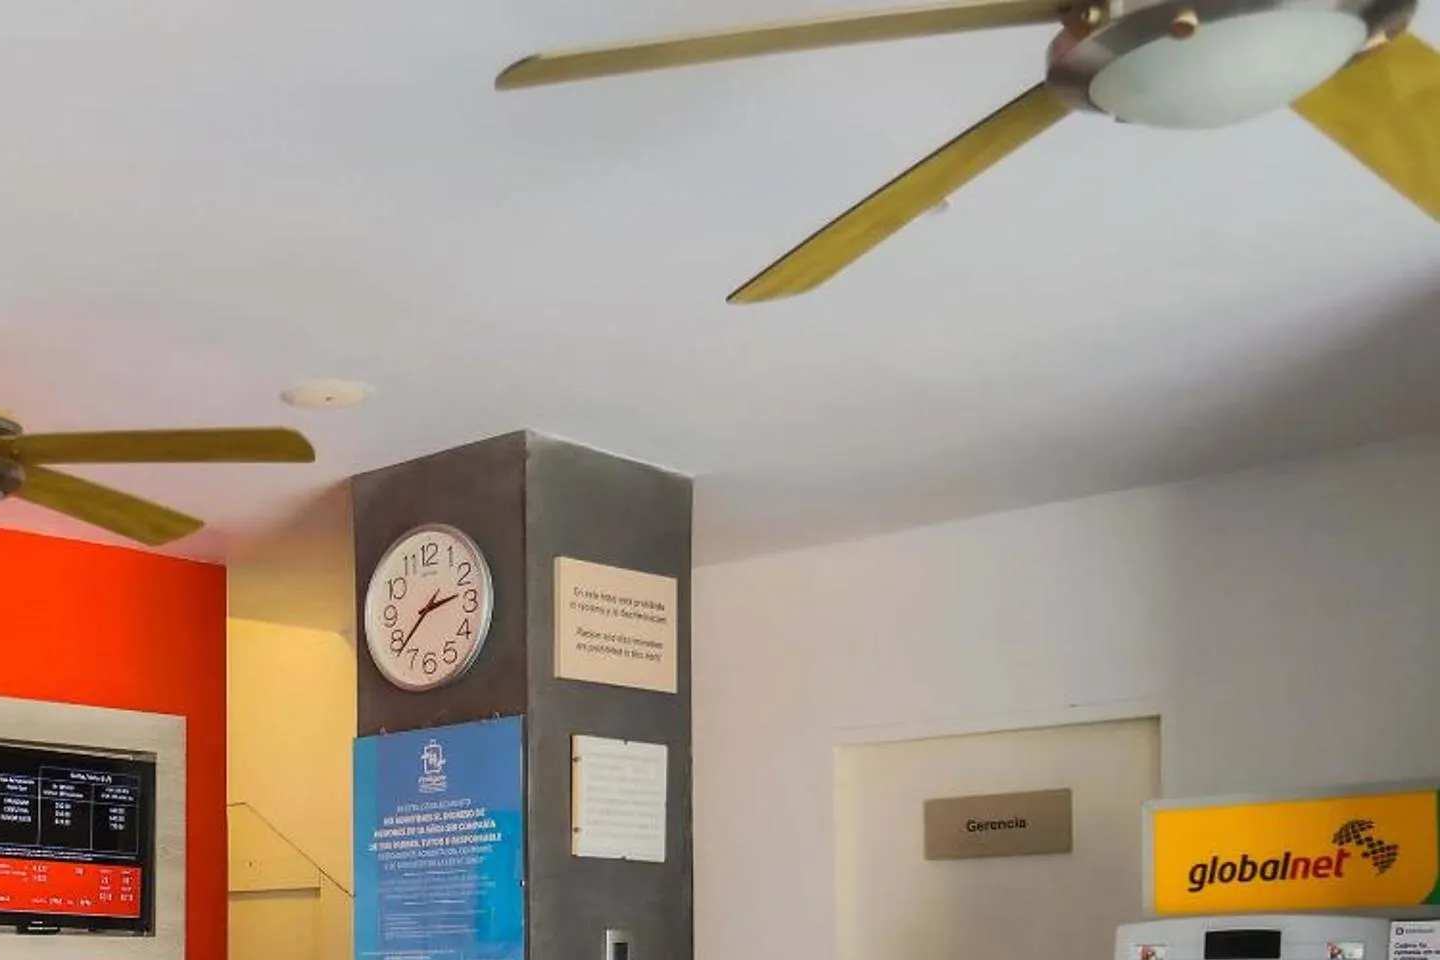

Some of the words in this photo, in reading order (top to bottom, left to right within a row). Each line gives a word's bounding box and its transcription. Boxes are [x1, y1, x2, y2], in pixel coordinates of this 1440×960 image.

[403, 554, 417, 576] 11
[420, 543, 439, 567] 12
[447, 545, 454, 567] 1
[457, 562, 472, 586] 2
[385, 577, 408, 601] 10
[462, 589, 479, 614] 3
[383, 604, 398, 628] 9
[390, 629, 405, 652] 8
[456, 618, 472, 640] 4
[407, 648, 420, 670] 7
[422, 652, 438, 675] 6
[443, 640, 458, 664] 5
[965, 816, 1030, 833] Gerencia
[1187, 849, 1352, 892] globalnet
